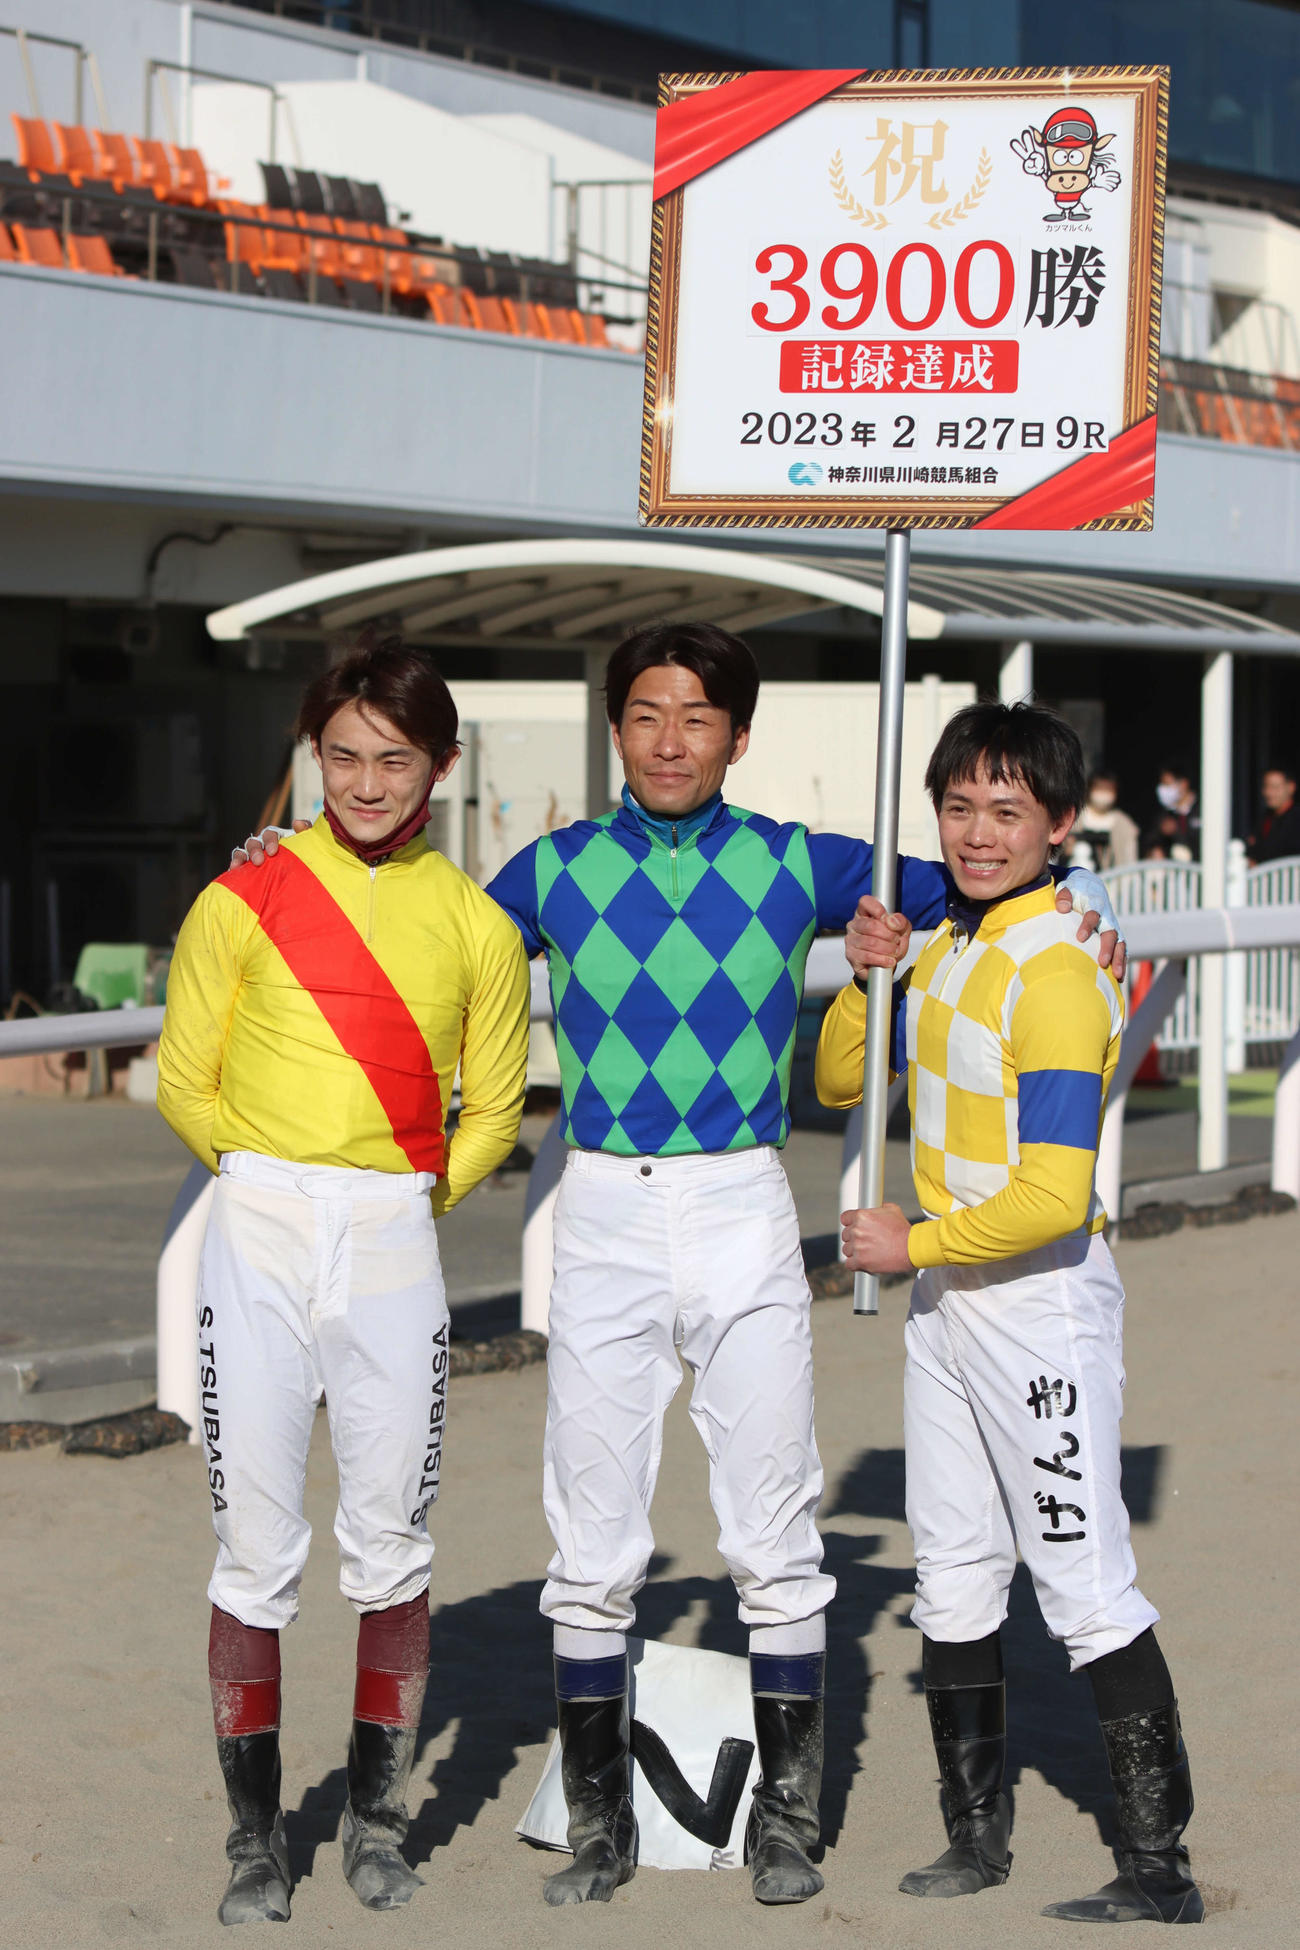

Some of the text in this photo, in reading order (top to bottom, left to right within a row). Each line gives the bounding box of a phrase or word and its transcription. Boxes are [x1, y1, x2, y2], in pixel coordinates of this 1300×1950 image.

[865, 117, 950, 206] 祝
[1045, 224, 1093, 233] カツマルくん
[800, 344, 995, 391] 記録達成
[828, 465, 999, 485] 神奈川県川崎競馬組合
[1027, 1375, 1086, 1542] げんき
